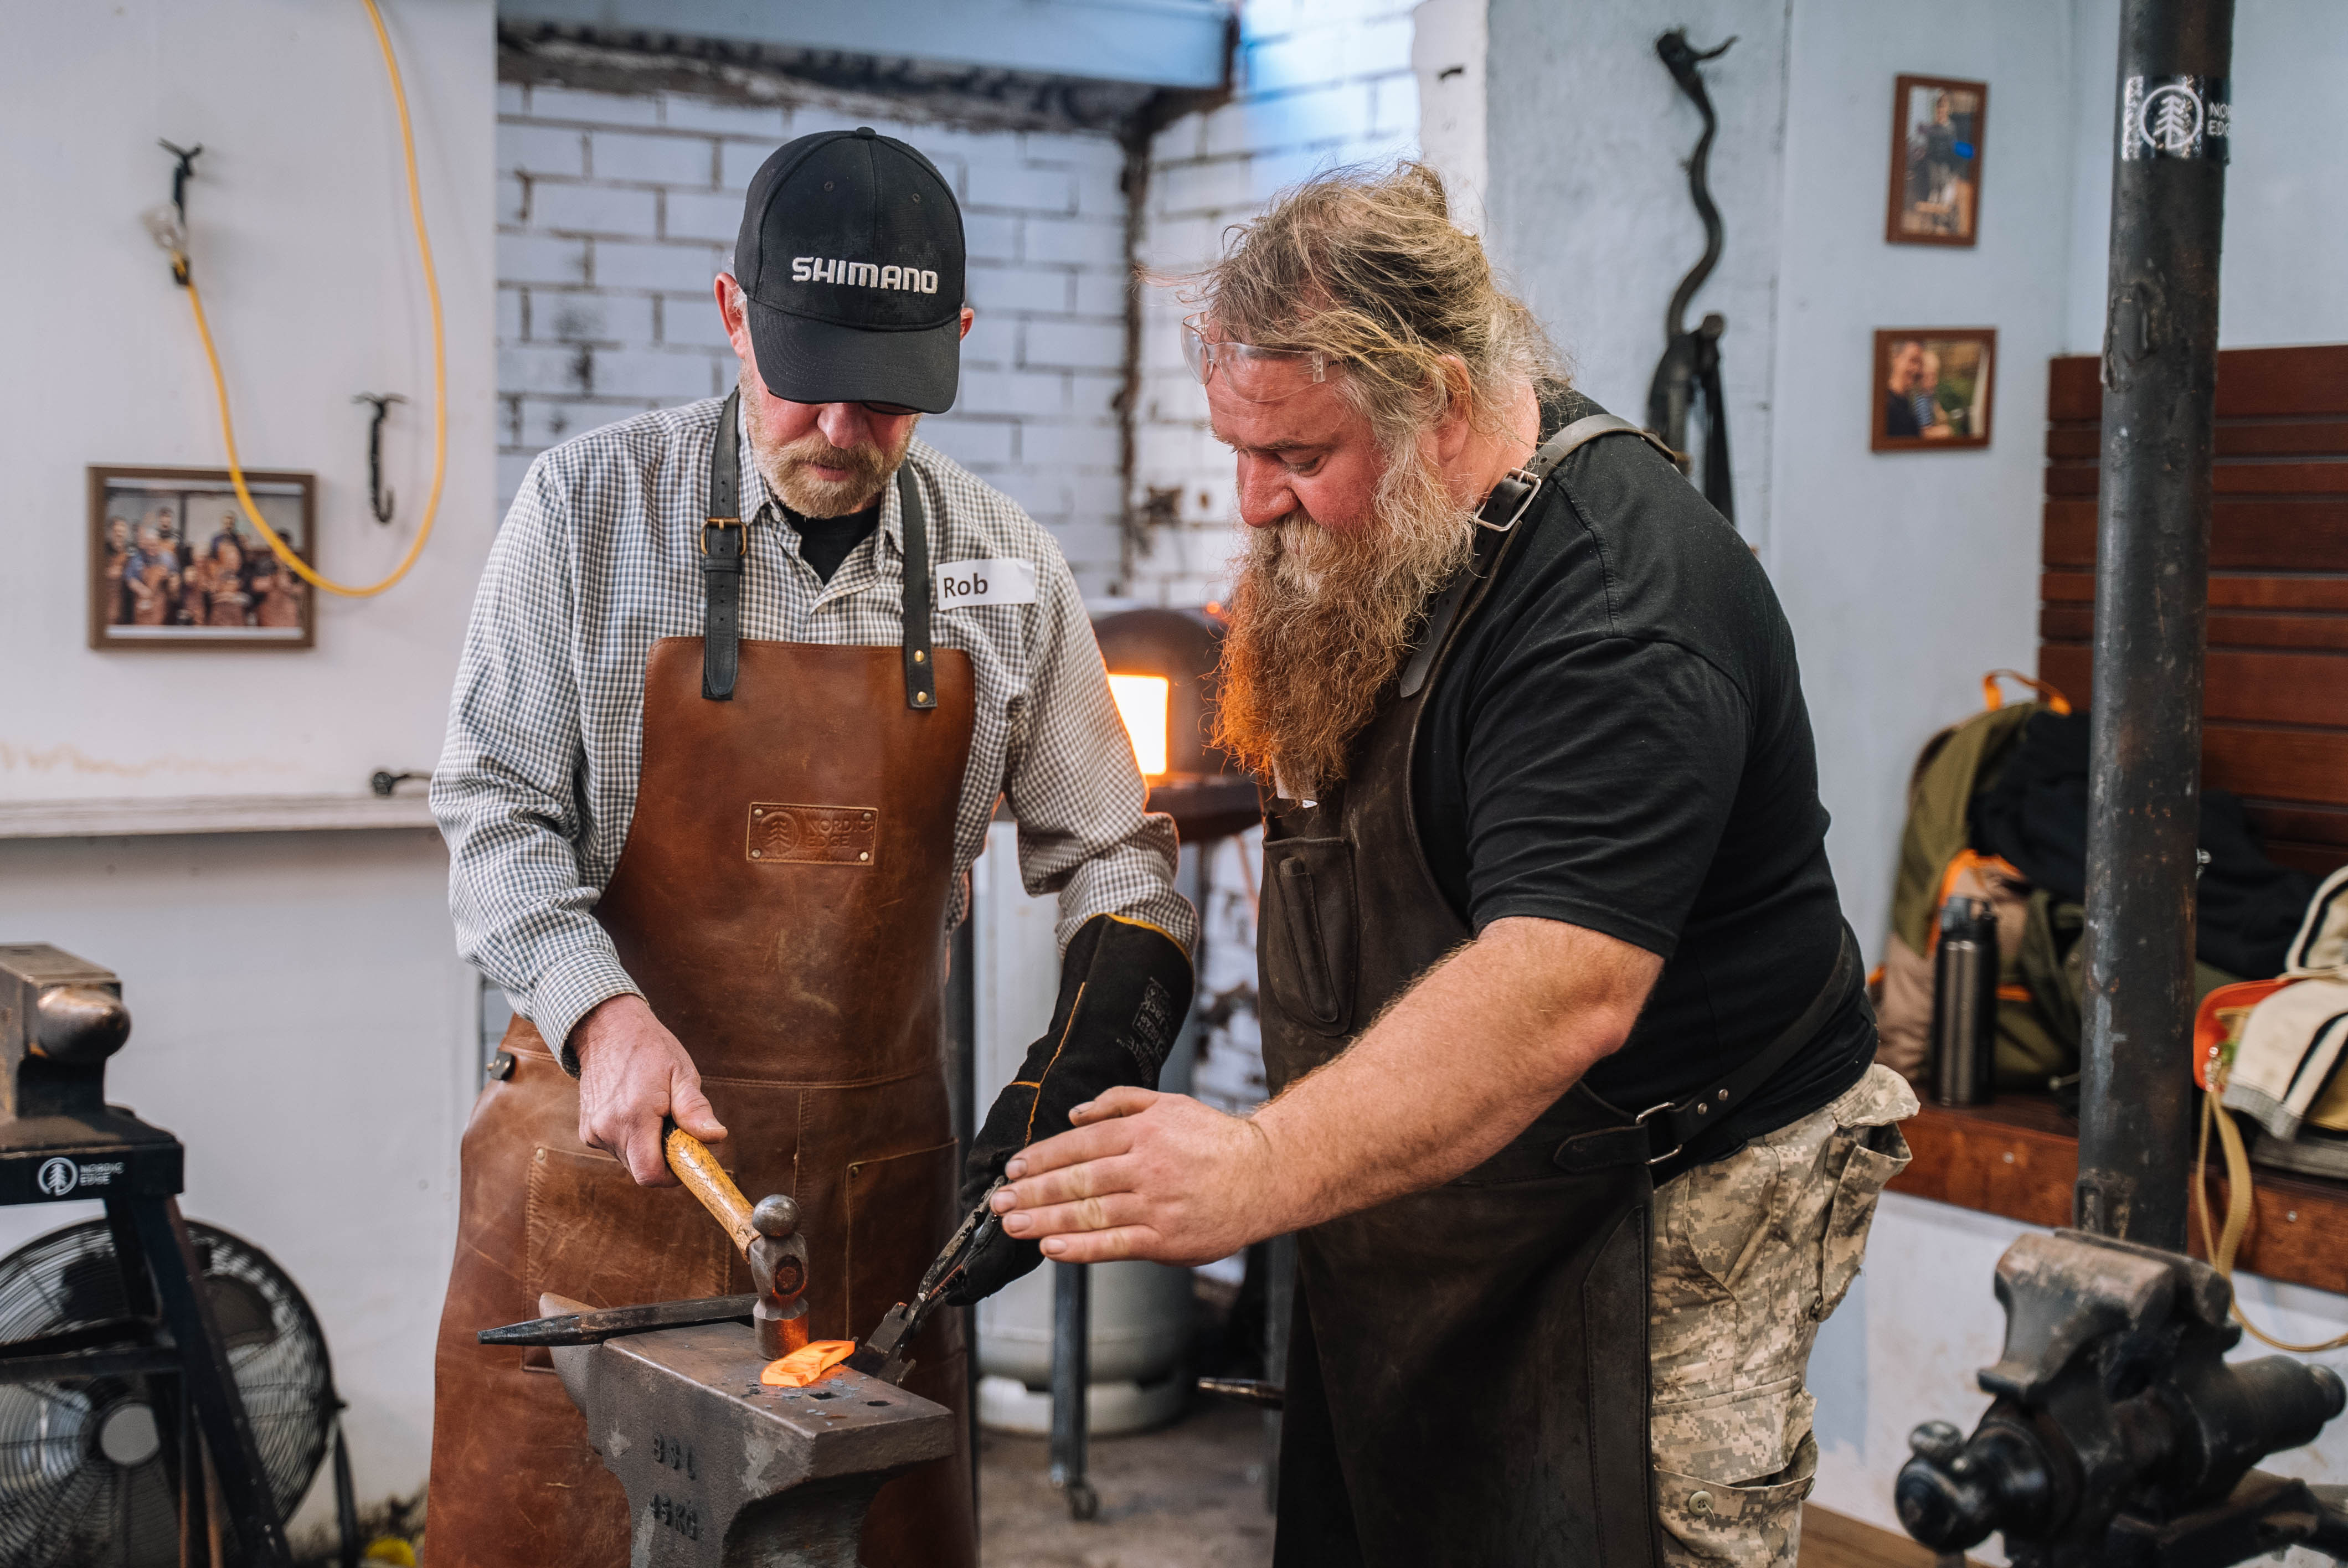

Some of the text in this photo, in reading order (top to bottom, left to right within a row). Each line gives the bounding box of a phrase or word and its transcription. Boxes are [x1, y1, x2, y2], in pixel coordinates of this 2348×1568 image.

[792, 257, 938, 294] SHIMANO
[944, 572, 988, 598] Rob
[806, 835, 851, 848] EDGE
